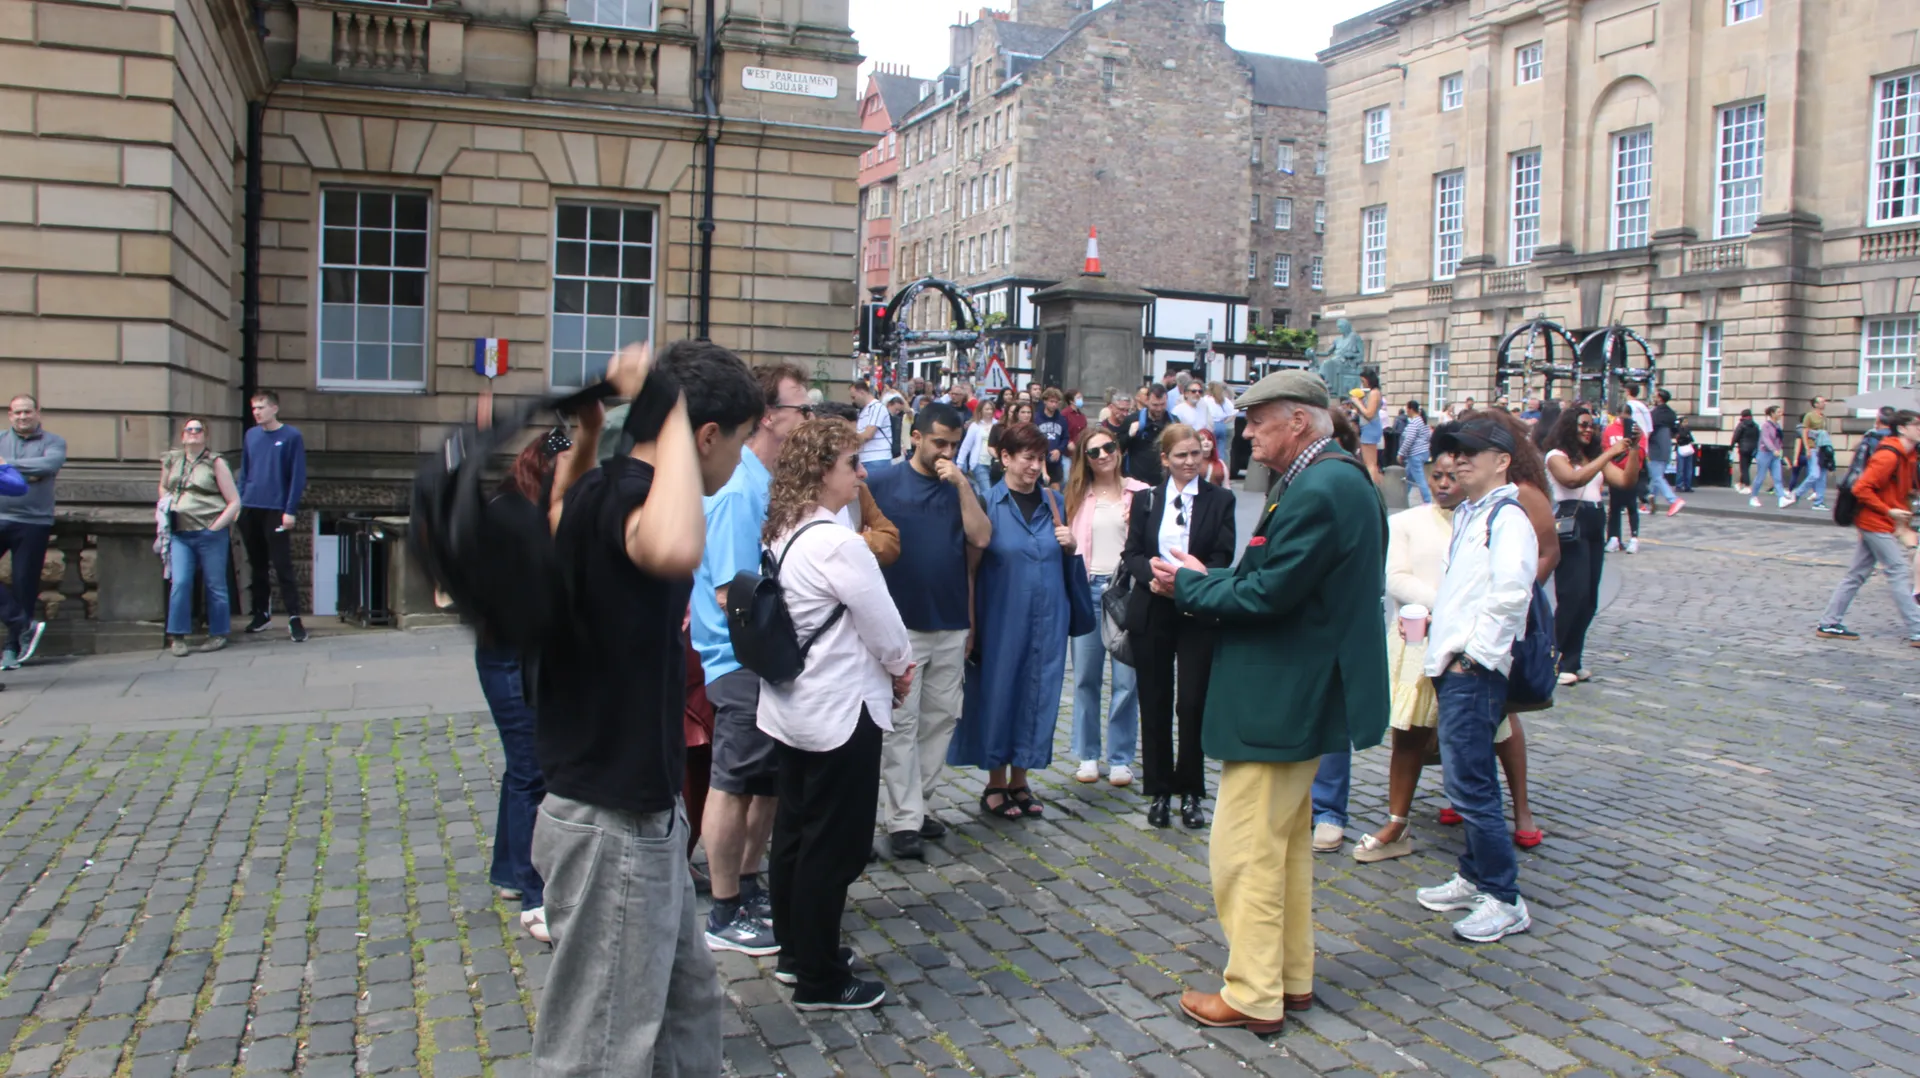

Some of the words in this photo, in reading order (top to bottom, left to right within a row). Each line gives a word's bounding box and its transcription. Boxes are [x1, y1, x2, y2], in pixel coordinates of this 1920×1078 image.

[746, 68, 771, 79] WEST
[776, 72, 834, 86] PARLIAMENT
[769, 81, 809, 93] SQUARE
